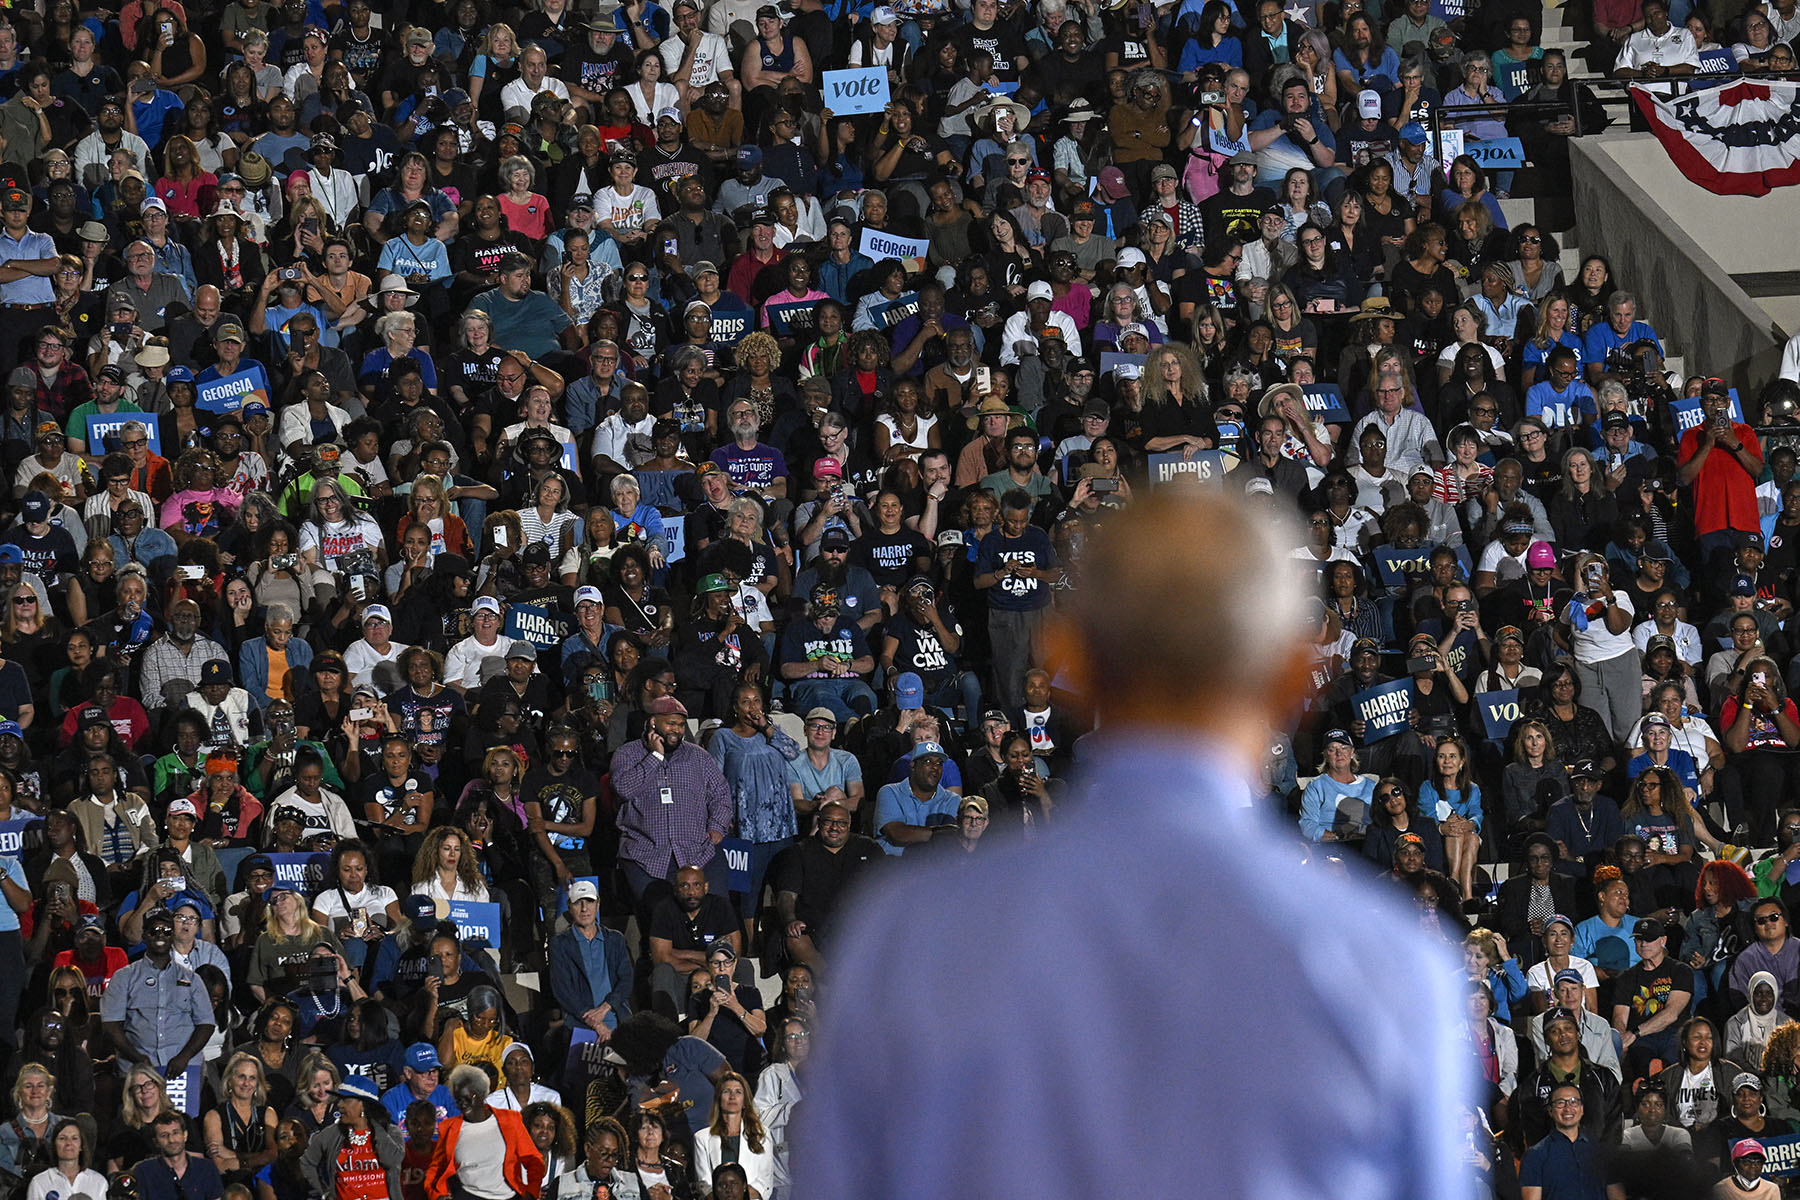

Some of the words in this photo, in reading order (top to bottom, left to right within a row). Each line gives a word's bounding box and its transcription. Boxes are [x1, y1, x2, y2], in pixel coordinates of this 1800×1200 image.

[1696, 56, 1731, 74] ARRIS
[832, 74, 882, 99] vote
[1471, 147, 1517, 162] vote
[474, 246, 518, 258] HARRIS
[869, 237, 918, 257] GEORGIA
[711, 318, 744, 334] ARRIS
[201, 378, 254, 403] GEORGIA
[1302, 392, 1341, 411] MALA
[323, 534, 363, 547] HARRIS
[323, 544, 350, 555] WALZ
[873, 544, 913, 559] HARRIS
[880, 558, 907, 567] WALZ
[1002, 577, 1038, 591] CAN
[517, 611, 569, 637] HARRIS
[523, 631, 561, 645] WALZ
[1360, 690, 1411, 720] HARRIS
[1371, 710, 1407, 730] WALZ
[275, 863, 324, 883] HARRIS
